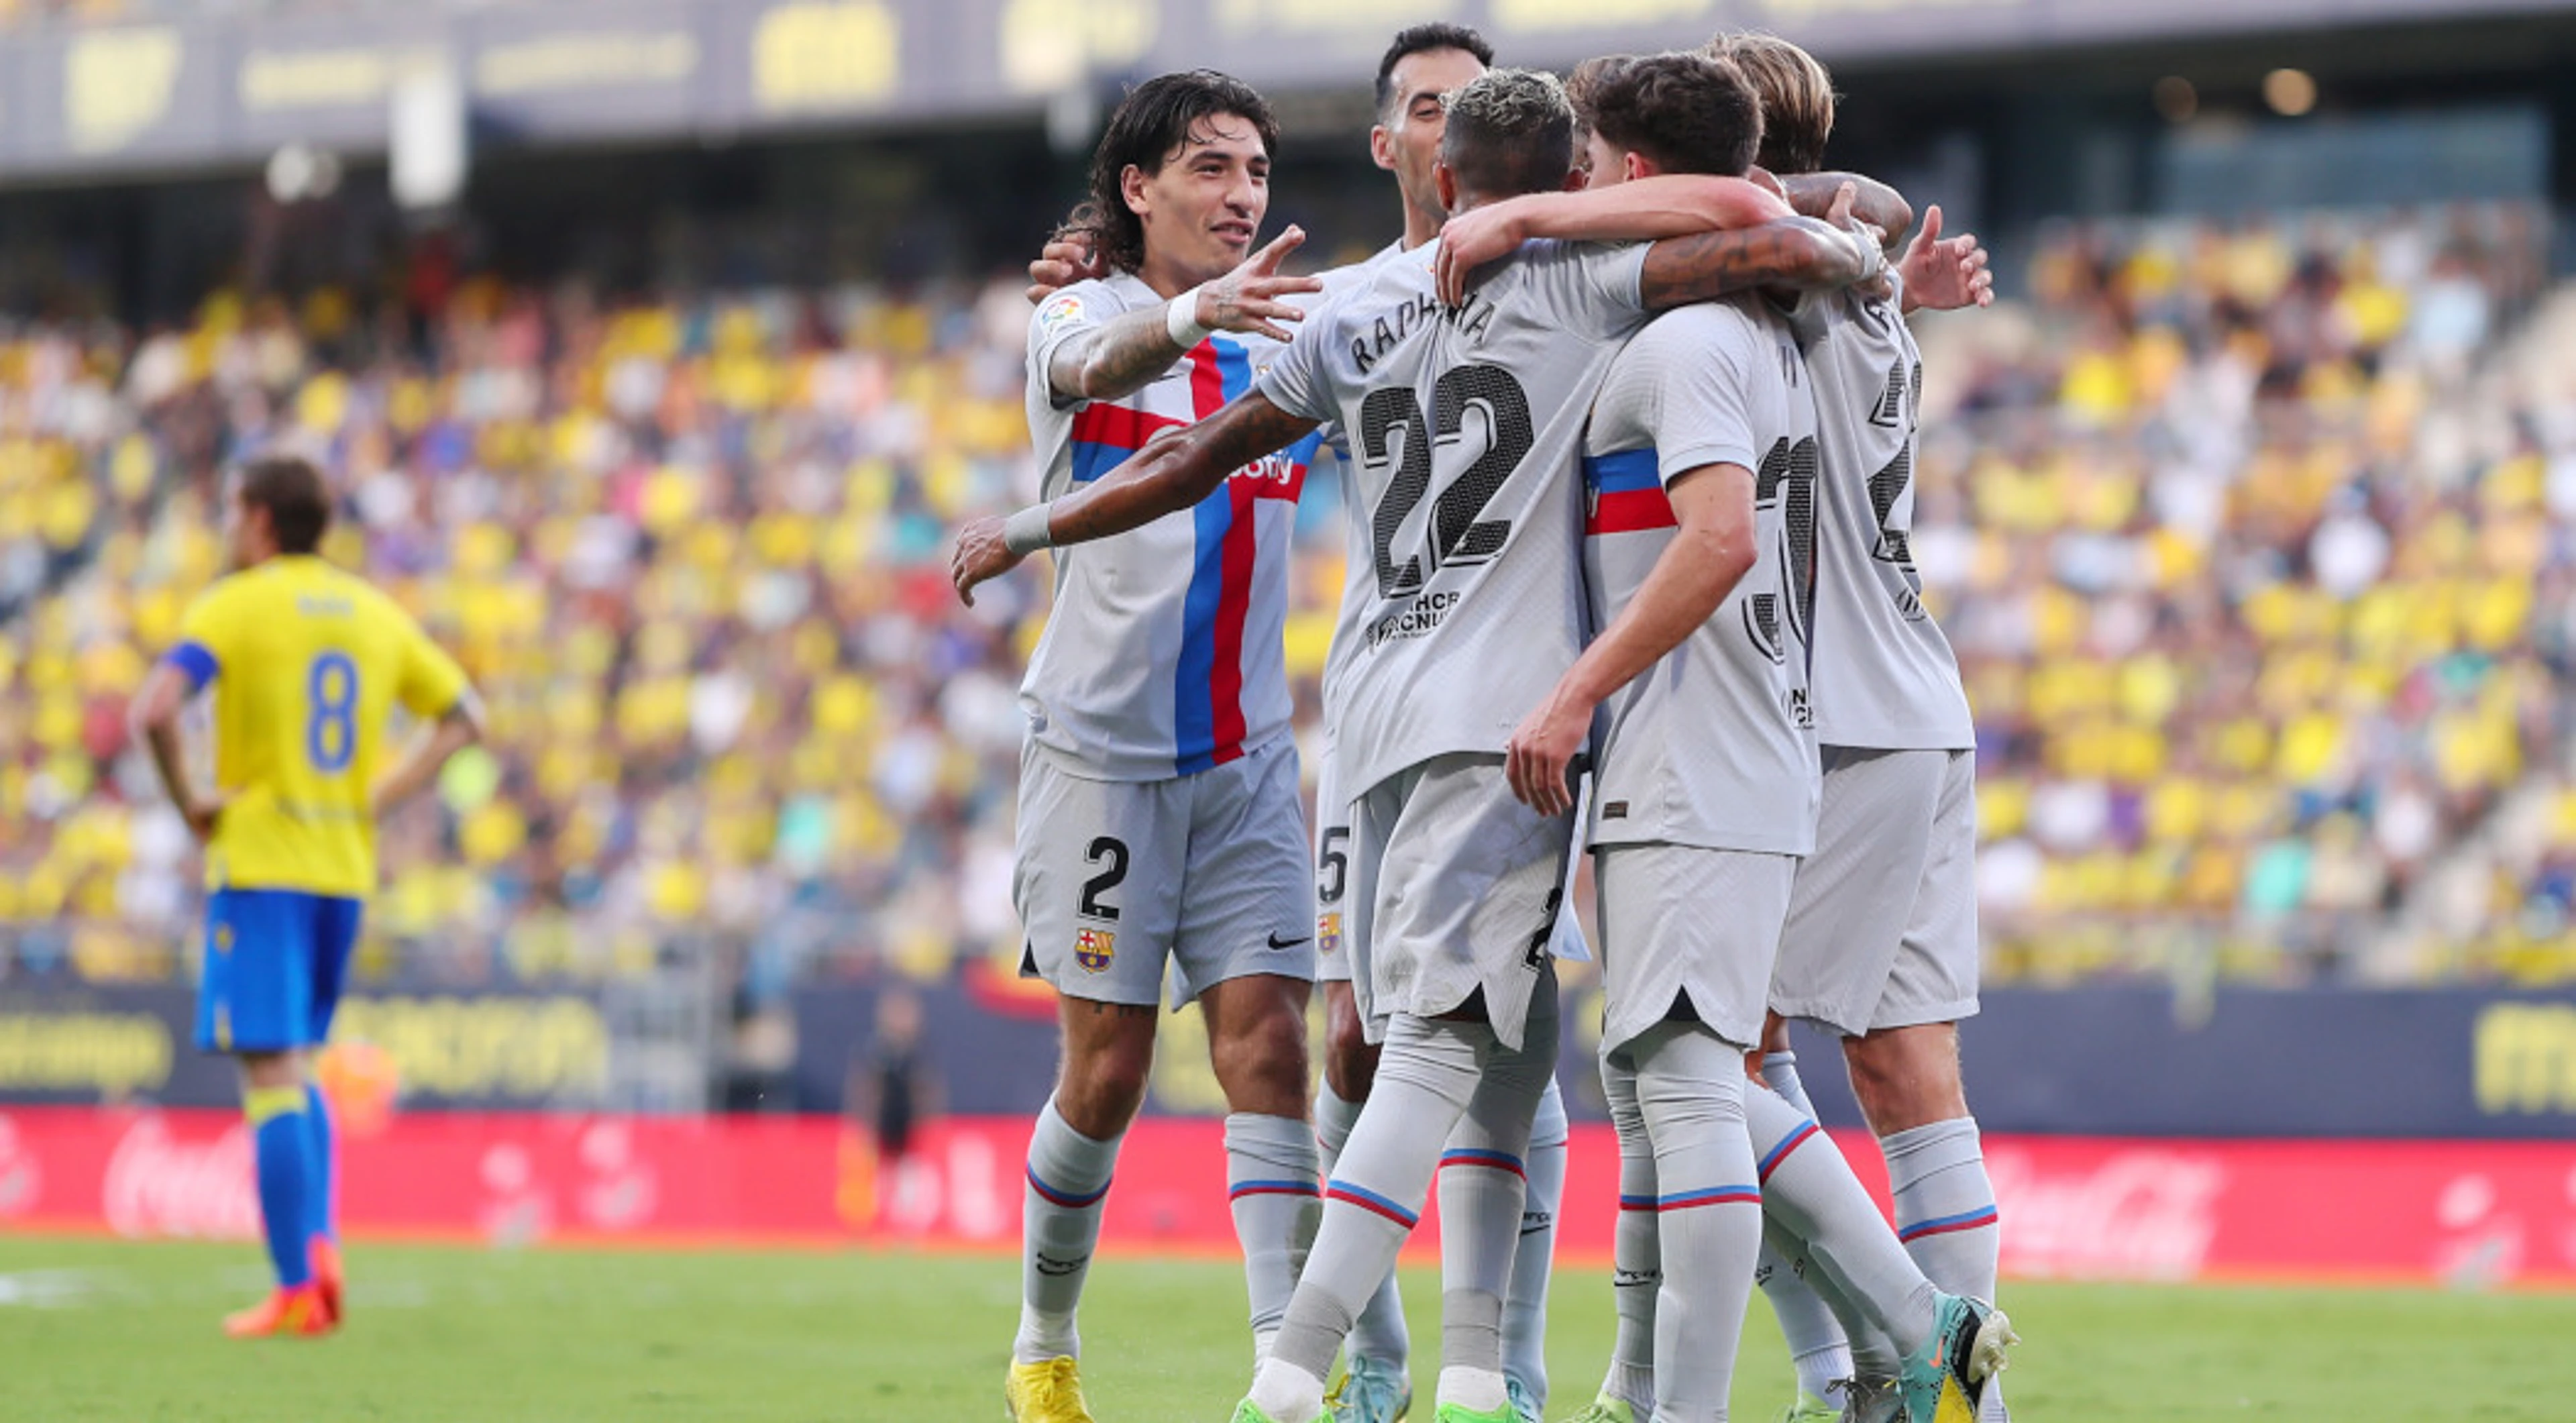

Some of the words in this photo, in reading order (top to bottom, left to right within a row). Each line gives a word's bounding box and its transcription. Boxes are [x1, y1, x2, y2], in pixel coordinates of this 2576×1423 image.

[1357, 364, 1536, 601] 22
[307, 649, 360, 776] 8
[1076, 836, 1129, 925] 2
[1319, 826, 1350, 906] 5
